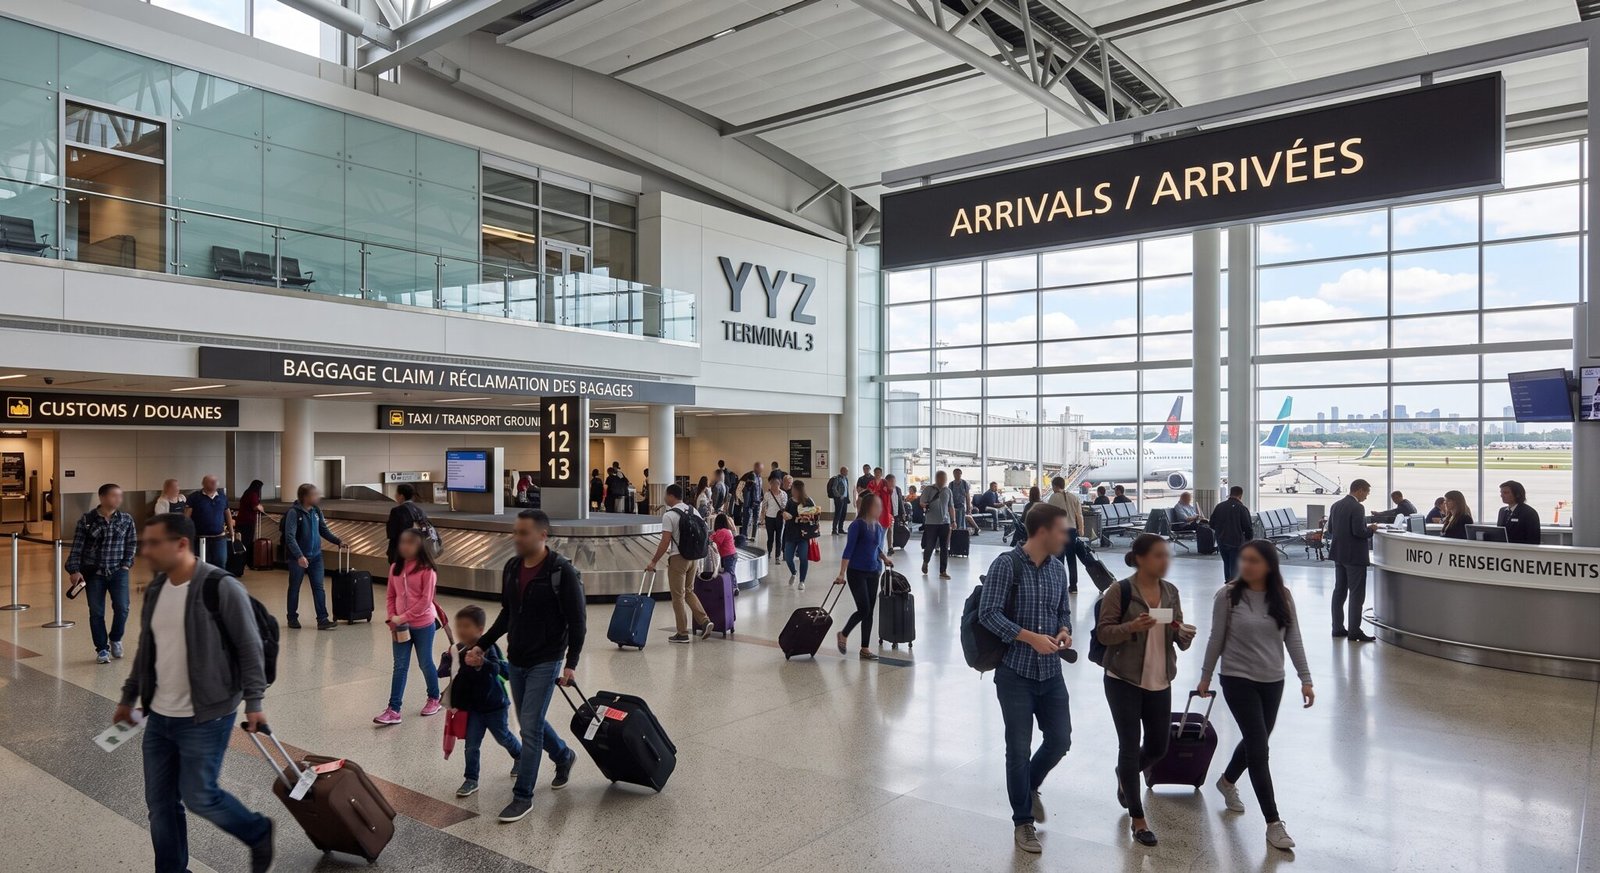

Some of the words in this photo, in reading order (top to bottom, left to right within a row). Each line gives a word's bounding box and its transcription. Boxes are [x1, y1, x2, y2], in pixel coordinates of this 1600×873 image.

[950, 182, 1112, 237] ARRIVALS
[1125, 175, 1141, 210] /
[1151, 136, 1365, 206] ARRIVÉES
[718, 256, 816, 325] YYZ
[721, 320, 802, 351] TERMINAL
[805, 333, 814, 352] 3
[284, 359, 376, 382] BAGGAGE
[382, 367, 434, 385] CLAIM
[439, 371, 445, 386] /
[450, 369, 549, 392] RÉCLAMATION
[553, 379, 576, 394] DES
[579, 381, 634, 398] BAGAGES
[40, 401, 127, 418] CUSTOMS
[133, 403, 139, 418] /
[144, 404, 222, 420] DOUANES
[407, 412, 431, 425] TAXI
[435, 413, 440, 426] /
[441, 413, 501, 427] TRANSPORT
[548, 403, 568, 425] 11
[548, 430, 570, 452] 12
[1097, 448, 1113, 456] AIR
[1115, 448, 1155, 456] CANDA
[548, 457, 570, 480] 13
[1406, 548, 1433, 564] INFO
[1438, 552, 1443, 566] /
[1449, 553, 1599, 579] RENSEIGNEMENTS
